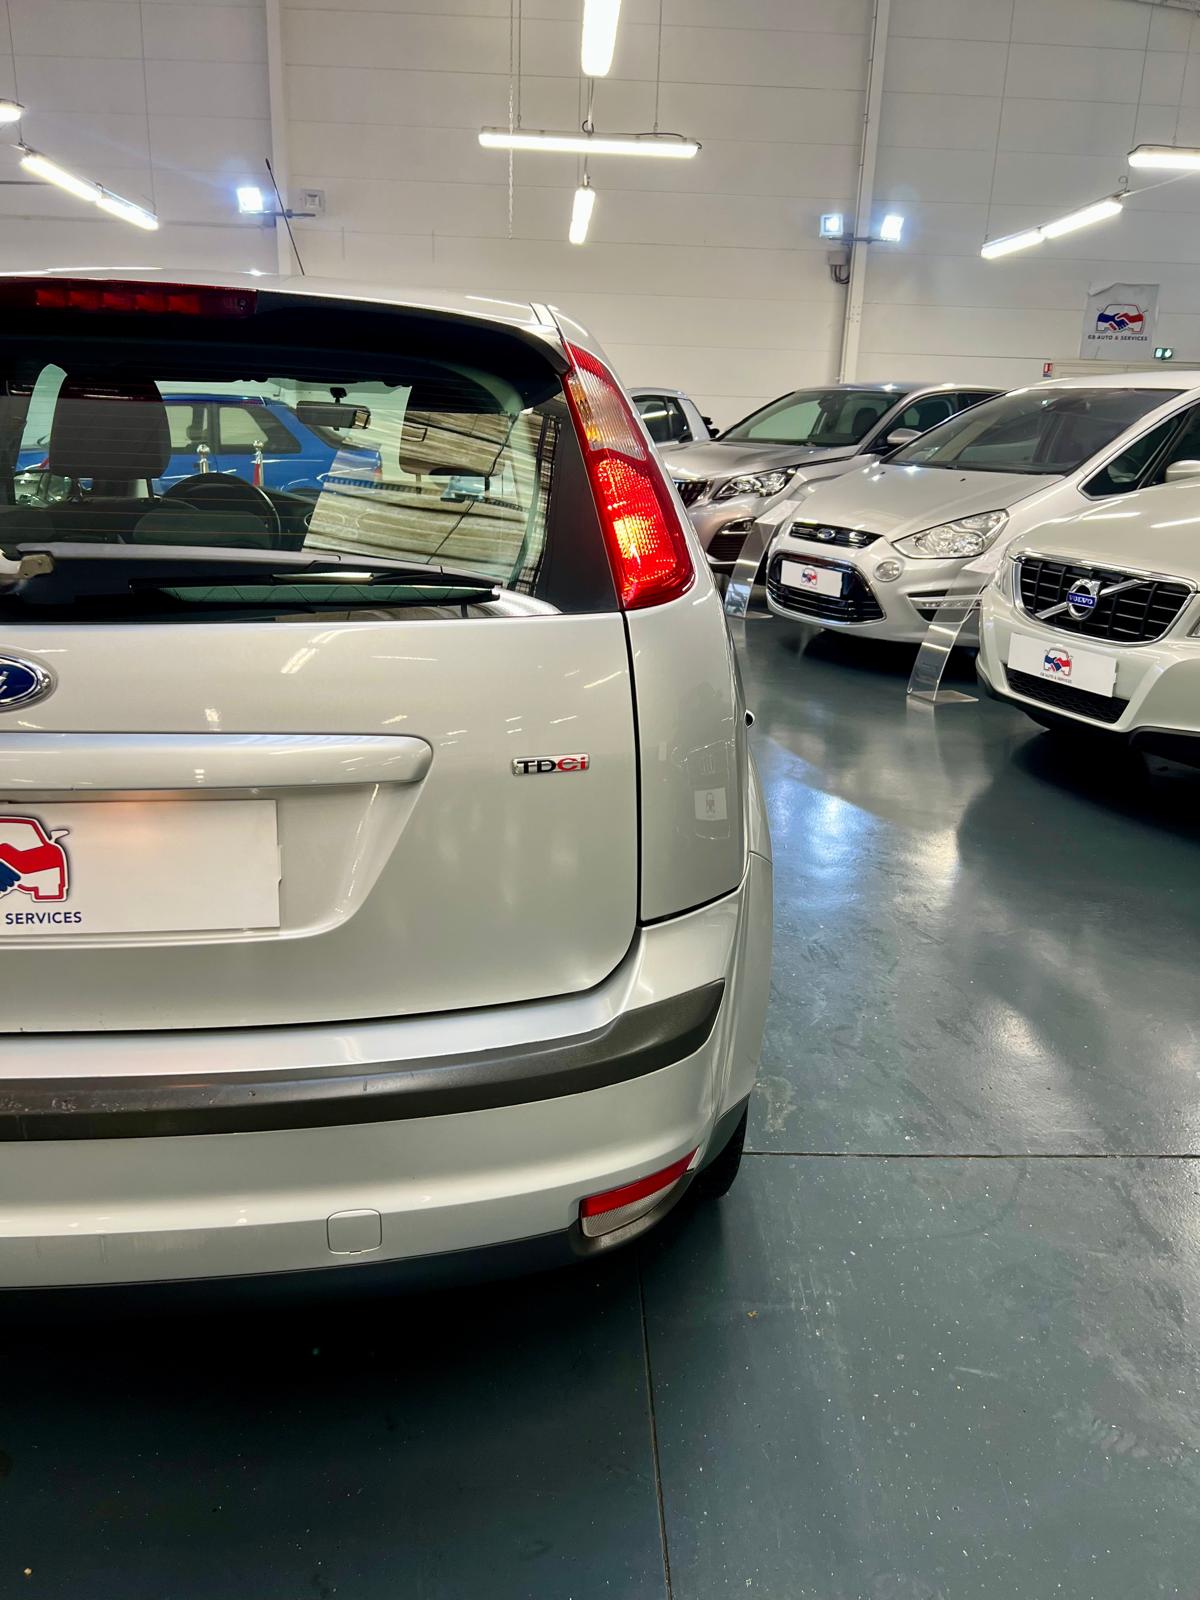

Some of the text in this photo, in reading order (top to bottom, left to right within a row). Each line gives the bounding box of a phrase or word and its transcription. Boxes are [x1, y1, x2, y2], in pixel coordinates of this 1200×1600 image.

[1068, 595, 1094, 605] VOLVO
[517, 756, 587, 774] TDCi
[5, 911, 82, 926] SERVICES
